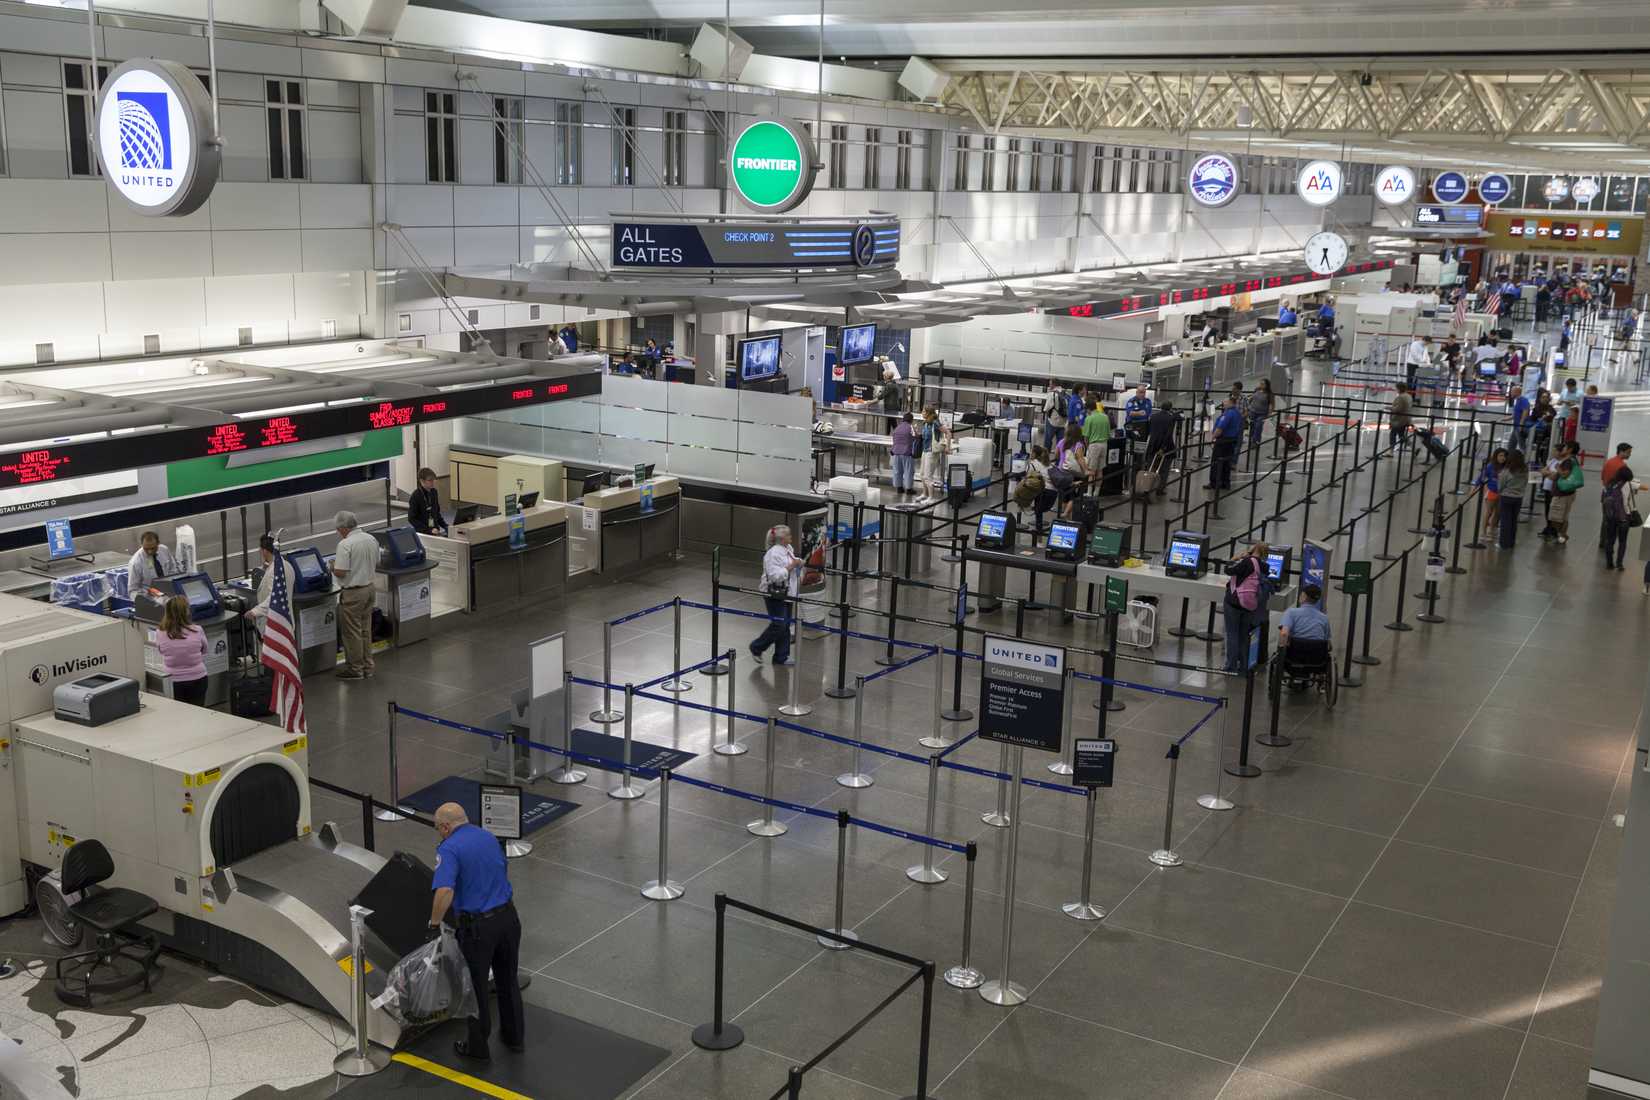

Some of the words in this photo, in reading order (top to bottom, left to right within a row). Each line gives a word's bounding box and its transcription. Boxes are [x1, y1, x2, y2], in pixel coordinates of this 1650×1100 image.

[736, 157, 797, 171] FRONTIER
[122, 175, 173, 187] UNITED
[621, 227, 656, 243] ALL
[724, 232, 748, 242] CHECK
[749, 232, 768, 242] POINT
[769, 232, 775, 242] 2
[620, 247, 683, 263] GATES
[215, 424, 238, 436] UNITED
[269, 418, 290, 428] UNITED
[22, 450, 49, 463] UNITED
[0, 506, 16, 514] STAR
[17, 500, 49, 511] ALLIANCE
[992, 648, 1042, 663] UNITED
[52, 654, 107, 677] InVision
[991, 666, 1013, 677] Global
[1014, 670, 1044, 682] Services
[989, 682, 1018, 694] Premier
[1019, 688, 1042, 699] Access
